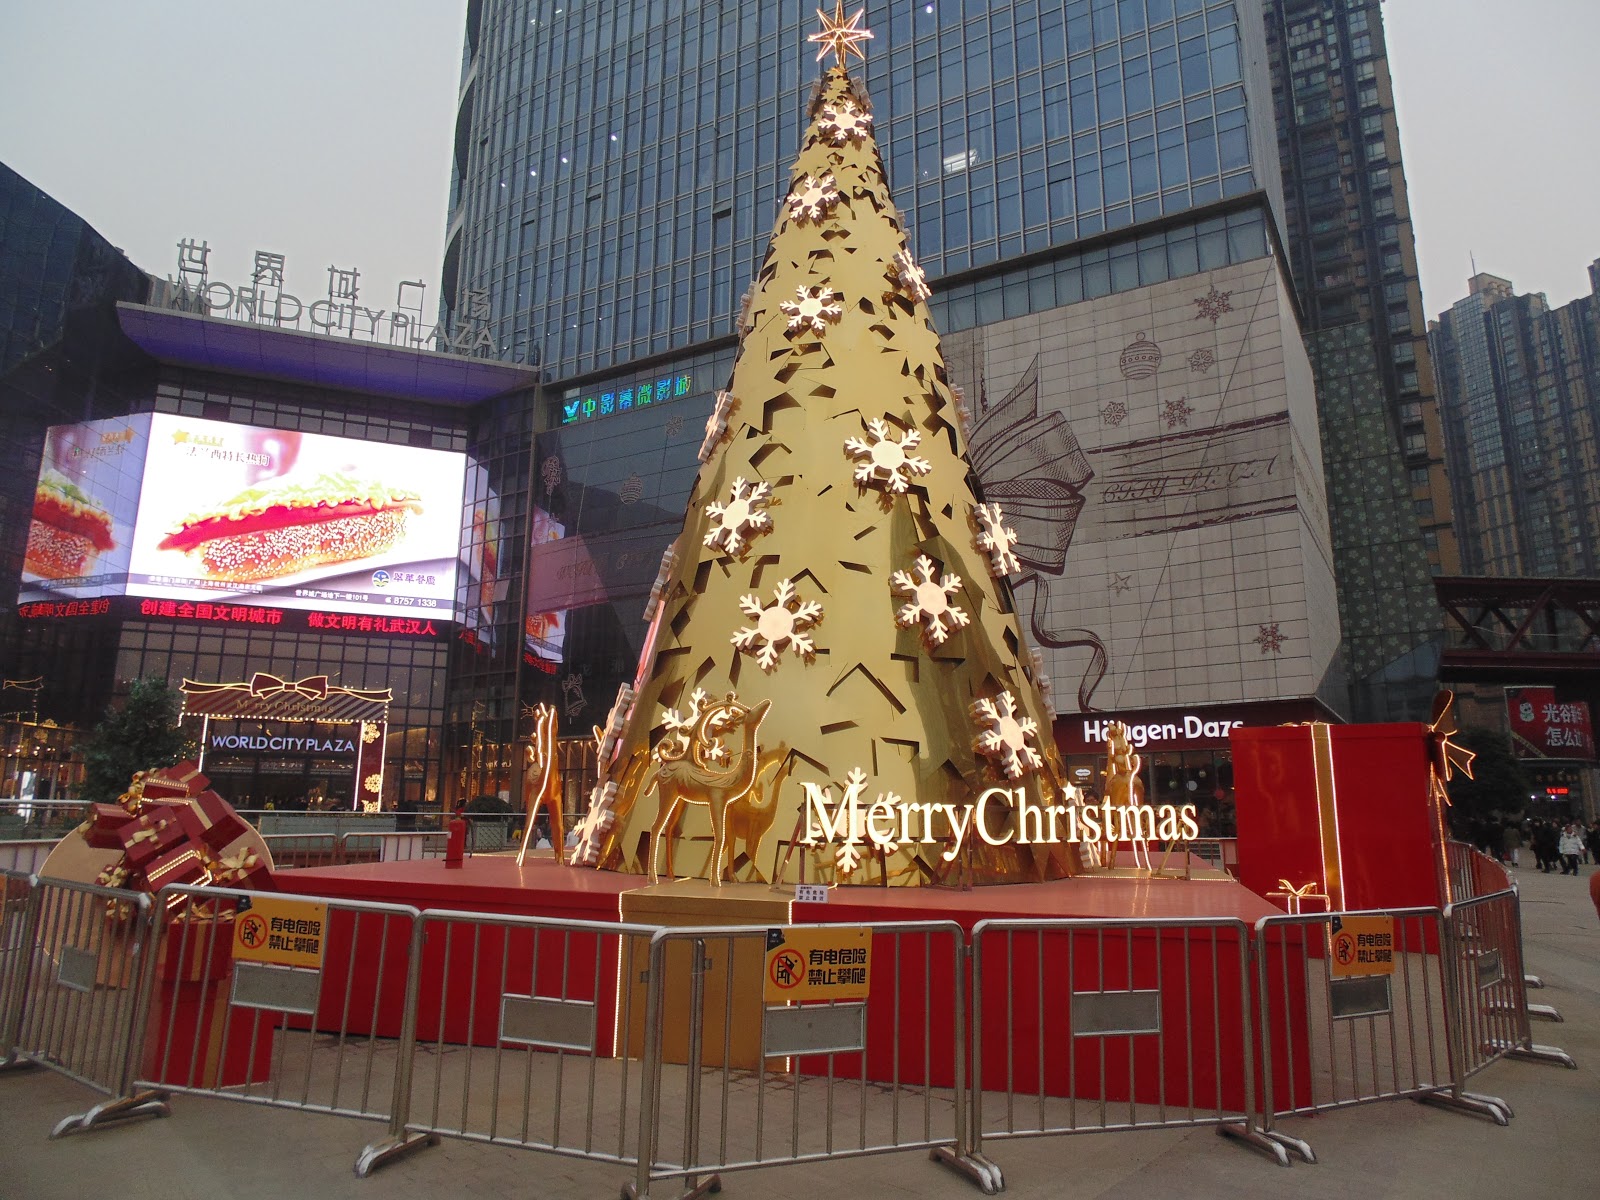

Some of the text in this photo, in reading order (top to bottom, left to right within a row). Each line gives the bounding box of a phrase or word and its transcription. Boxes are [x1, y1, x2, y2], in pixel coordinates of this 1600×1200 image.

[168, 273, 500, 354] WORLD CITY PLAZA
[393, 597, 437, 607] 8757 1338
[140, 599, 437, 636] 创建全国文明城市 做文明有礼武汉人
[271, 917, 321, 936] 有电危险
[268, 934, 319, 954] 禁止攀爬
[1357, 933, 1392, 947] 有电危险
[809, 948, 867, 965] 有电危险
[808, 967, 866, 985] 禁止攀爬
